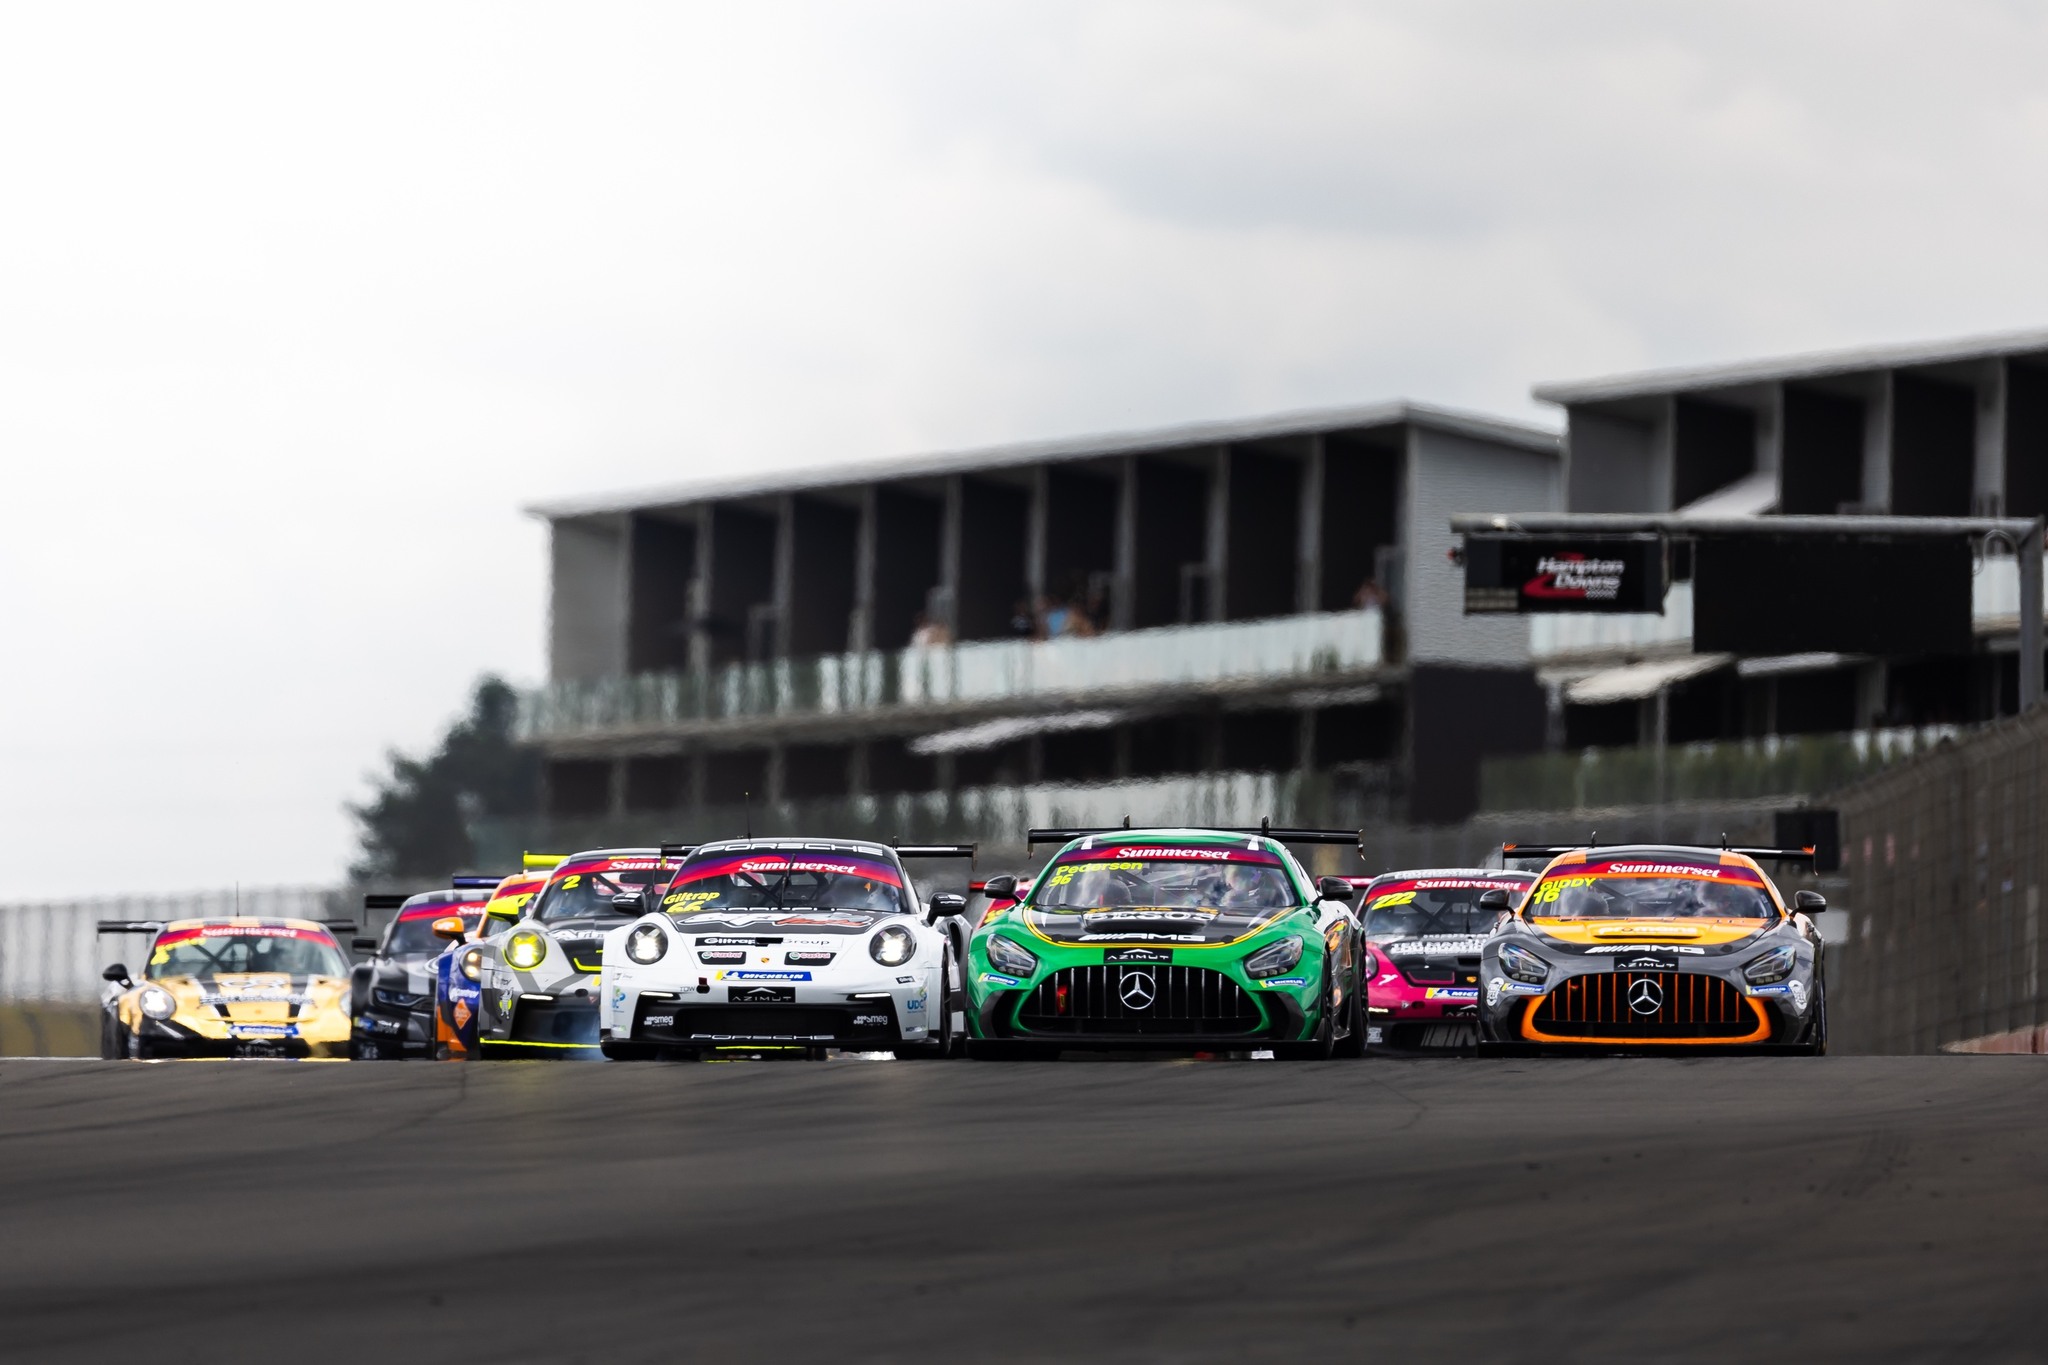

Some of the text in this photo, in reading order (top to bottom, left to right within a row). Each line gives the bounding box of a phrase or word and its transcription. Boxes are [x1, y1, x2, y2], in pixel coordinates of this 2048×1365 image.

[1537, 557, 1625, 575] Hampton
[698, 842, 884, 857] PORSCHE
[1116, 847, 1231, 860] Summerset
[608, 861, 681, 870] Summe
[738, 861, 858, 875] Summerset
[1055, 863, 1143, 876] Pedersen
[1607, 863, 1721, 878] Summerset
[562, 875, 581, 890] 2
[1414, 880, 1522, 890] Summerset
[1539, 877, 1597, 892] GIDDY
[663, 892, 720, 905] Giltrap
[1533, 888, 1561, 905] 16
[653, 1016, 674, 1026] smeg
[866, 1015, 888, 1025] smeg
